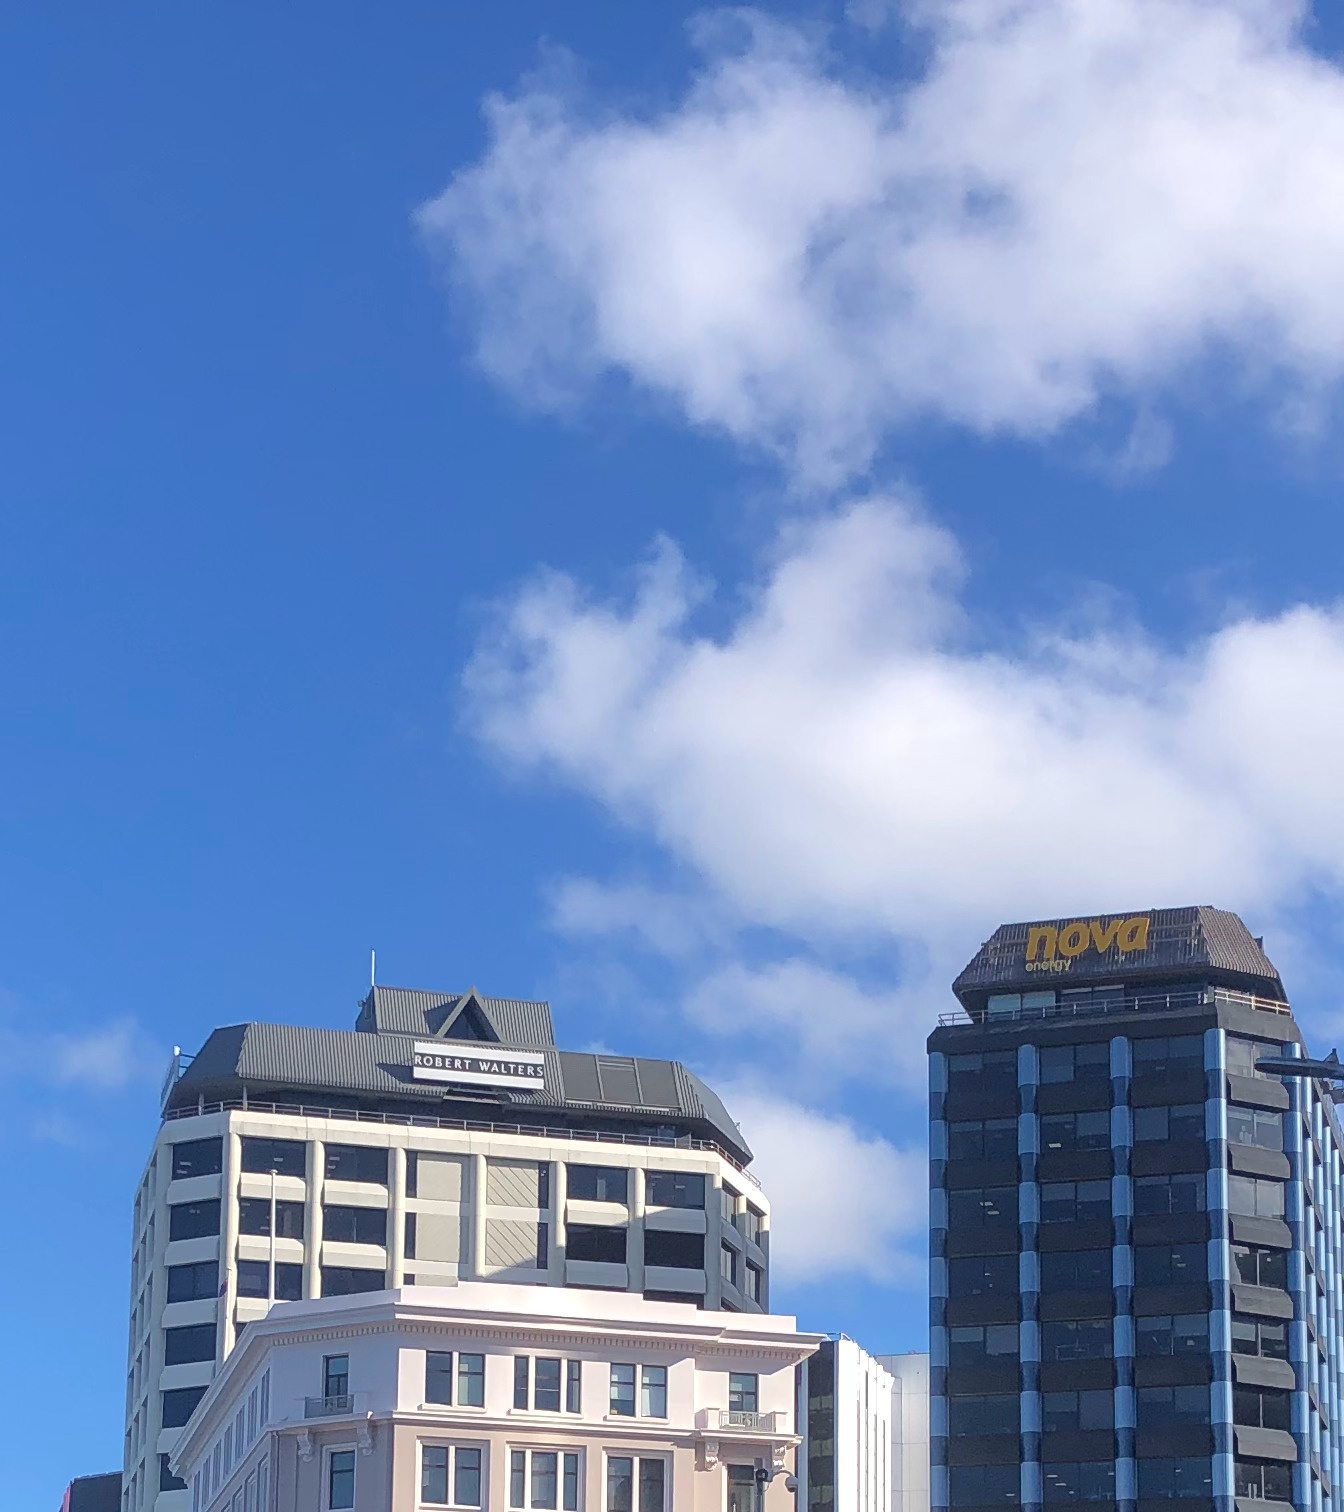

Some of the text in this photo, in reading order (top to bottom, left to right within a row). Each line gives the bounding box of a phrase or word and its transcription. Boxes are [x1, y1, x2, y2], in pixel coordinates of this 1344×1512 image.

[1026, 917, 1150, 960] nova
[1025, 959, 1072, 973] energy
[414, 1055, 544, 1076] ROBERT WALTERS
